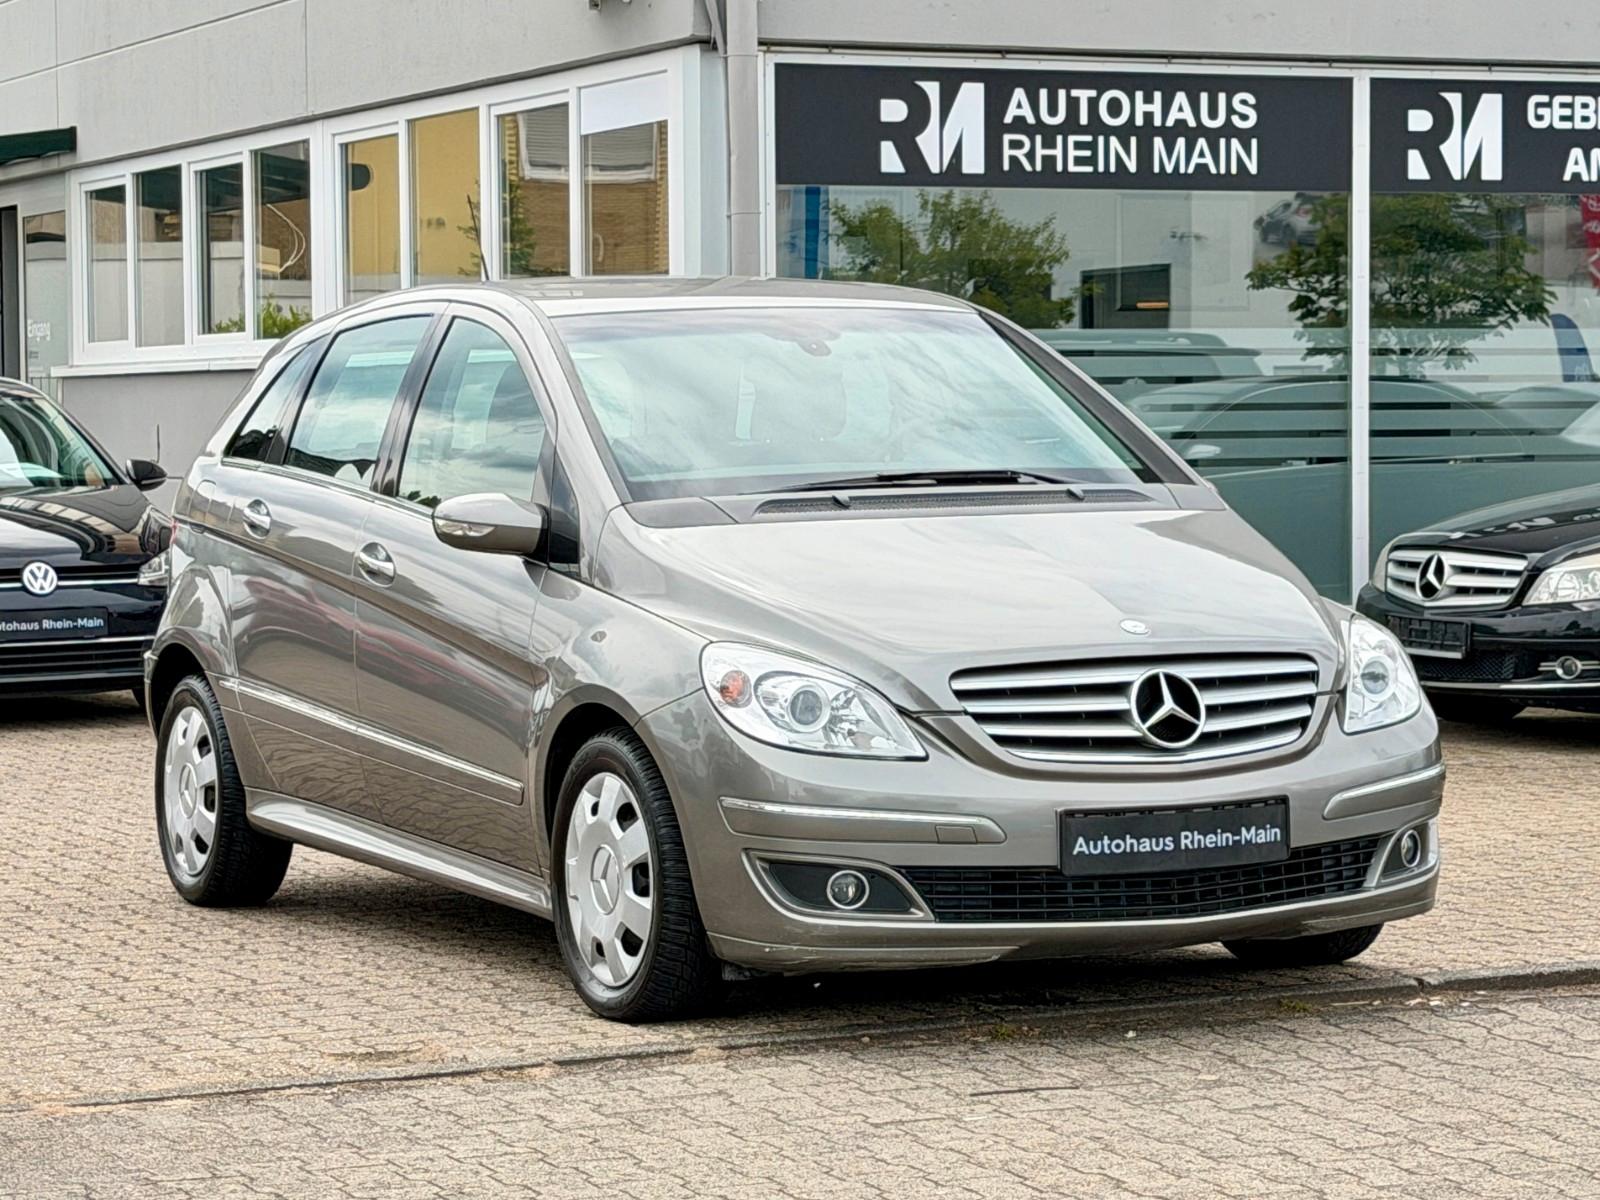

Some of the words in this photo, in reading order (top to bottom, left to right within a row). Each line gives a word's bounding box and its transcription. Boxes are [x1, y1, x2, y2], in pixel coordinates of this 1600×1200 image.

[1003, 87, 1258, 128] AUTOHAUS
[1527, 95, 1600, 130] GEB
[1002, 133, 1136, 173] RHEIN
[1153, 137, 1258, 175] MAIN
[0, 620, 40, 631] tohaus
[42, 616, 104, 630] Rhein-Main
[1072, 834, 1175, 855] Autohaus
[1180, 824, 1281, 850] Rhein-Main
